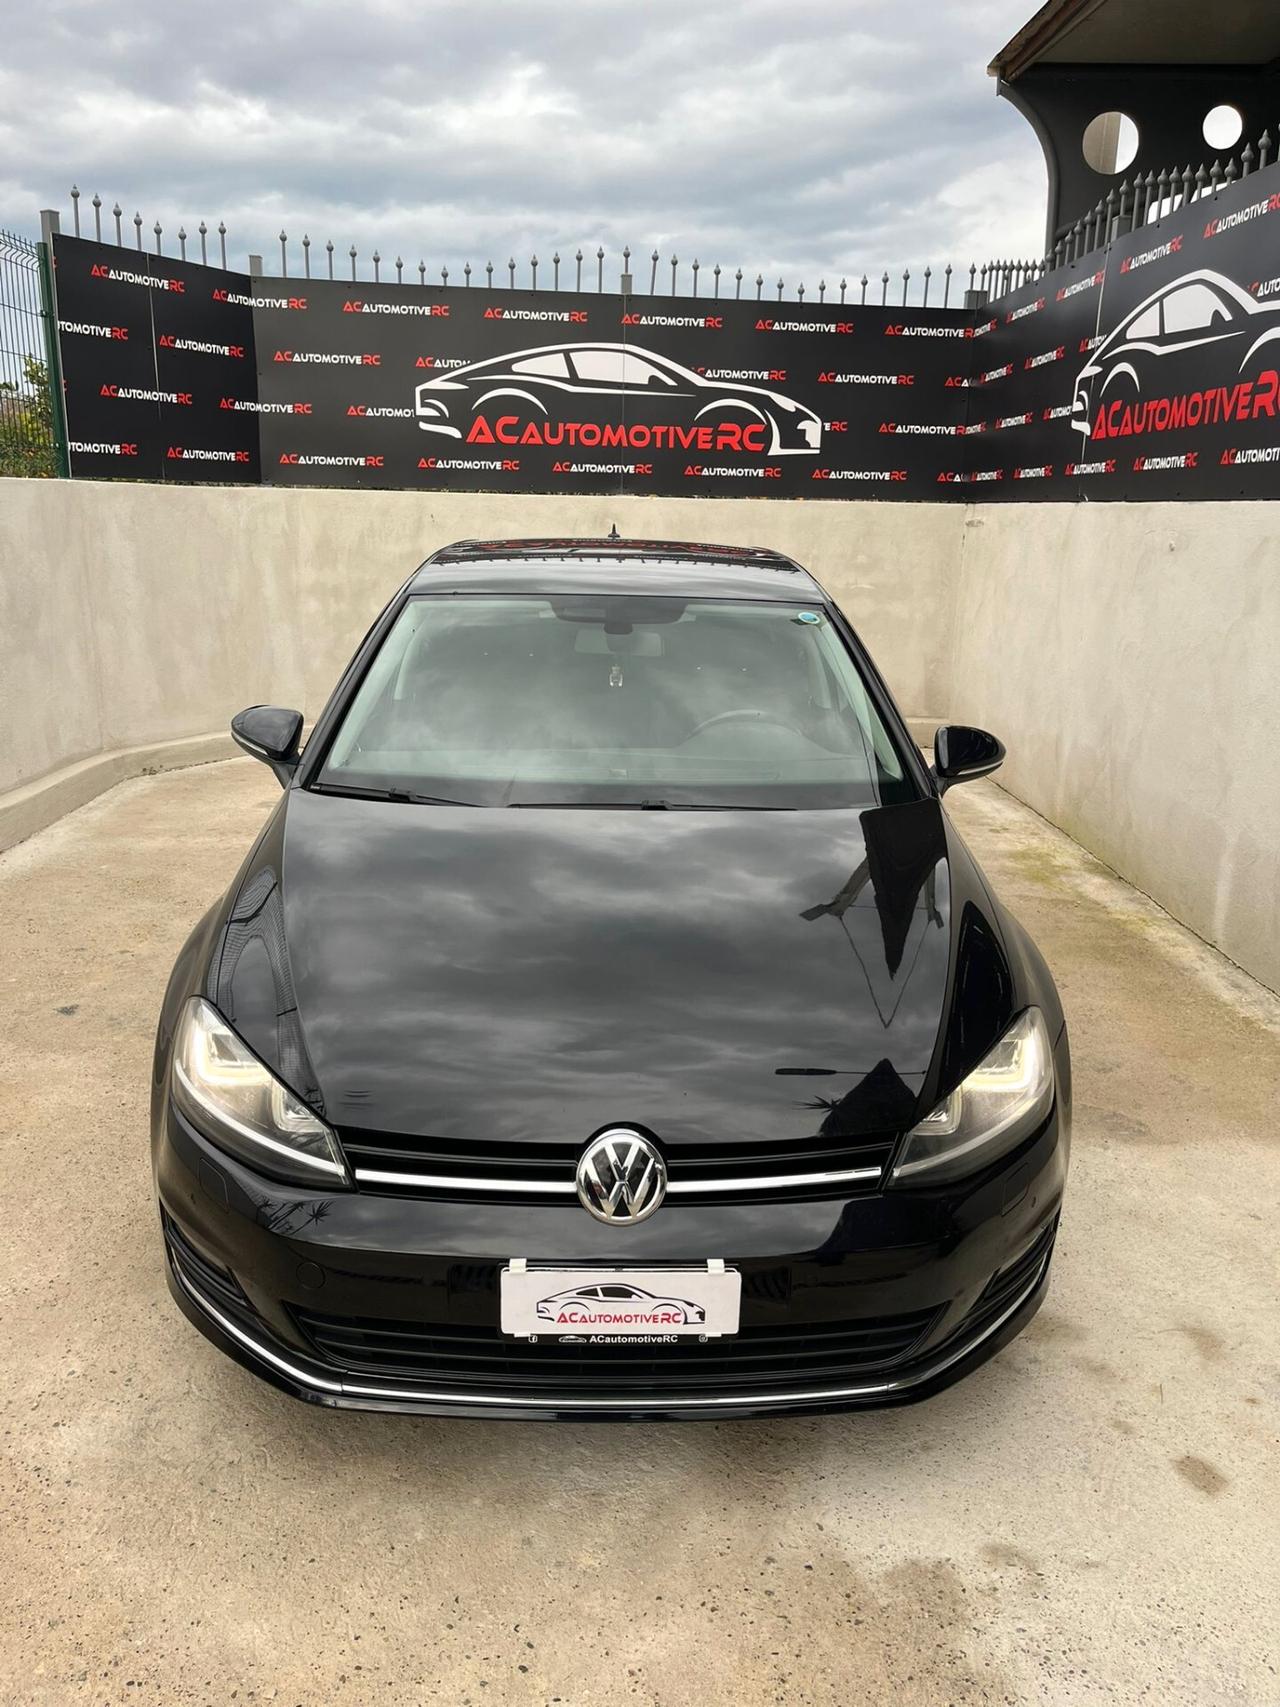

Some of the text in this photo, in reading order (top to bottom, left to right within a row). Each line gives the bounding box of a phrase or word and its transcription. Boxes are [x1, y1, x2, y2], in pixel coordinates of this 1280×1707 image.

[57, 320, 128, 340] TOMOTIVERC
[1091, 369, 1280, 440] ACAUTOMOTIVER
[466, 414, 766, 452] ACAUTOMOTIVERC
[67, 441, 138, 456] TOMOTIVERC
[589, 1335, 679, 1344] ACautomotiveRC
